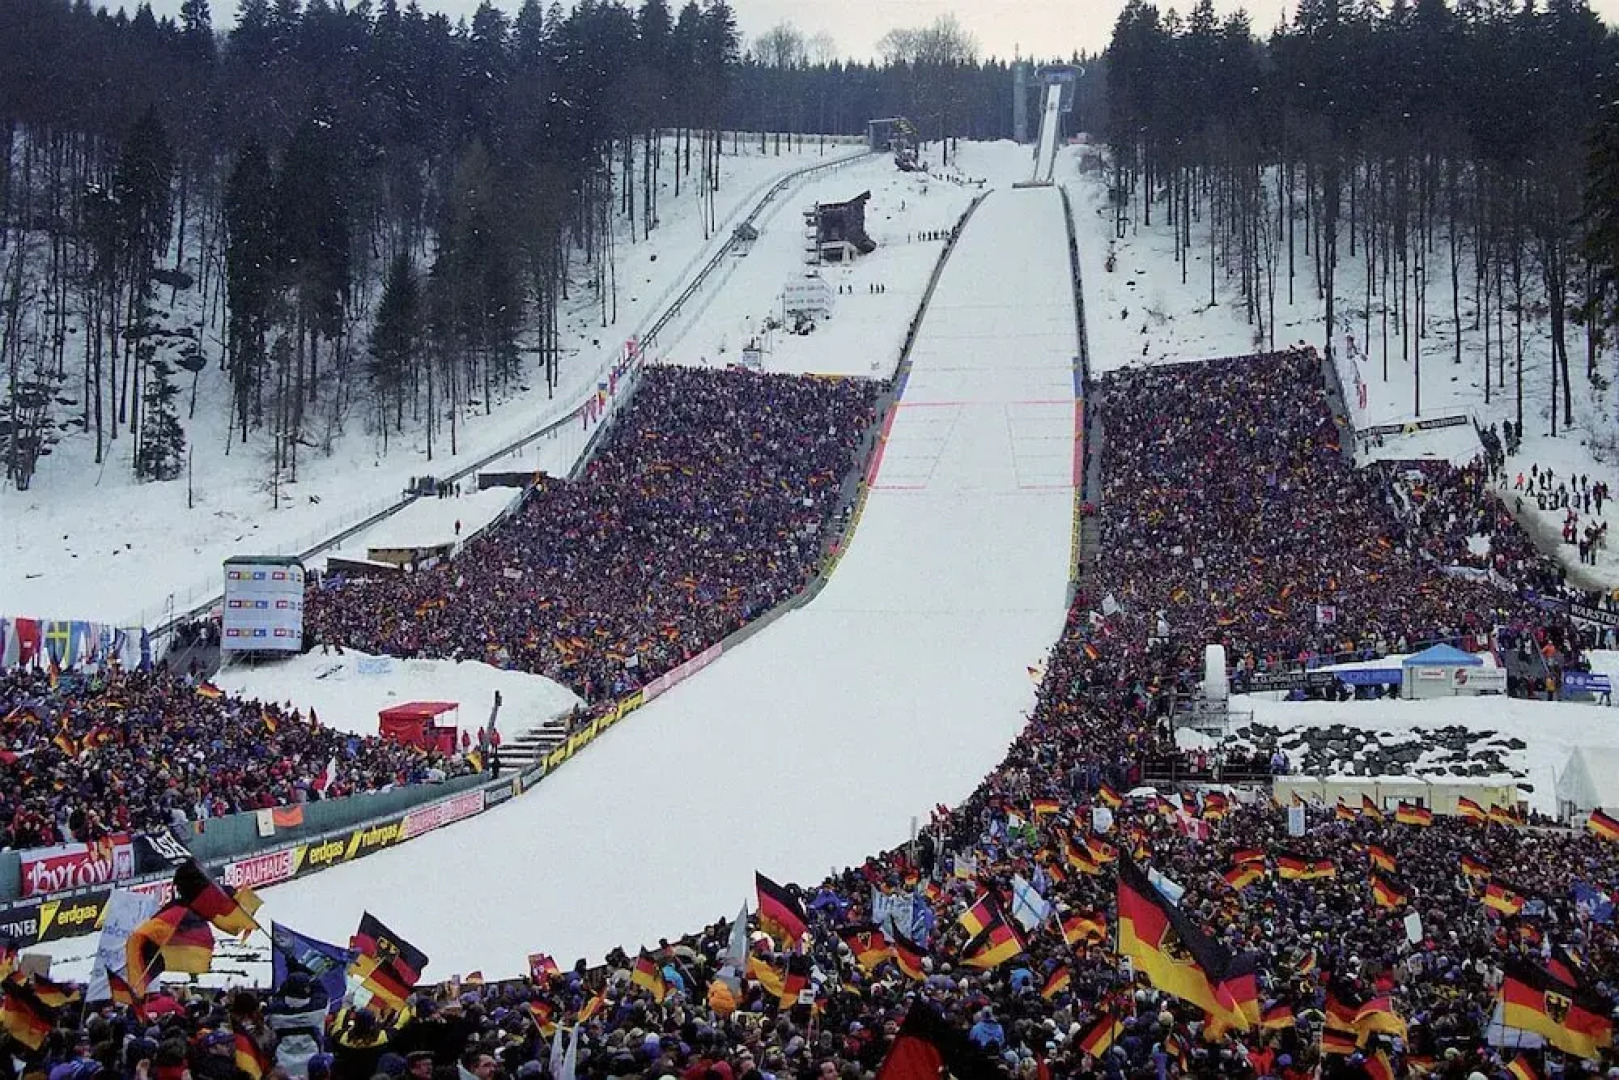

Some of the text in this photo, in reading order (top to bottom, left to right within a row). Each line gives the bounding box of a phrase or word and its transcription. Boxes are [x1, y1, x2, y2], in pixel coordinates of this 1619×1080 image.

[310, 840, 343, 863] erdgas
[236, 853, 290, 885] BAUHAUS
[57, 904, 98, 925] erdgas
